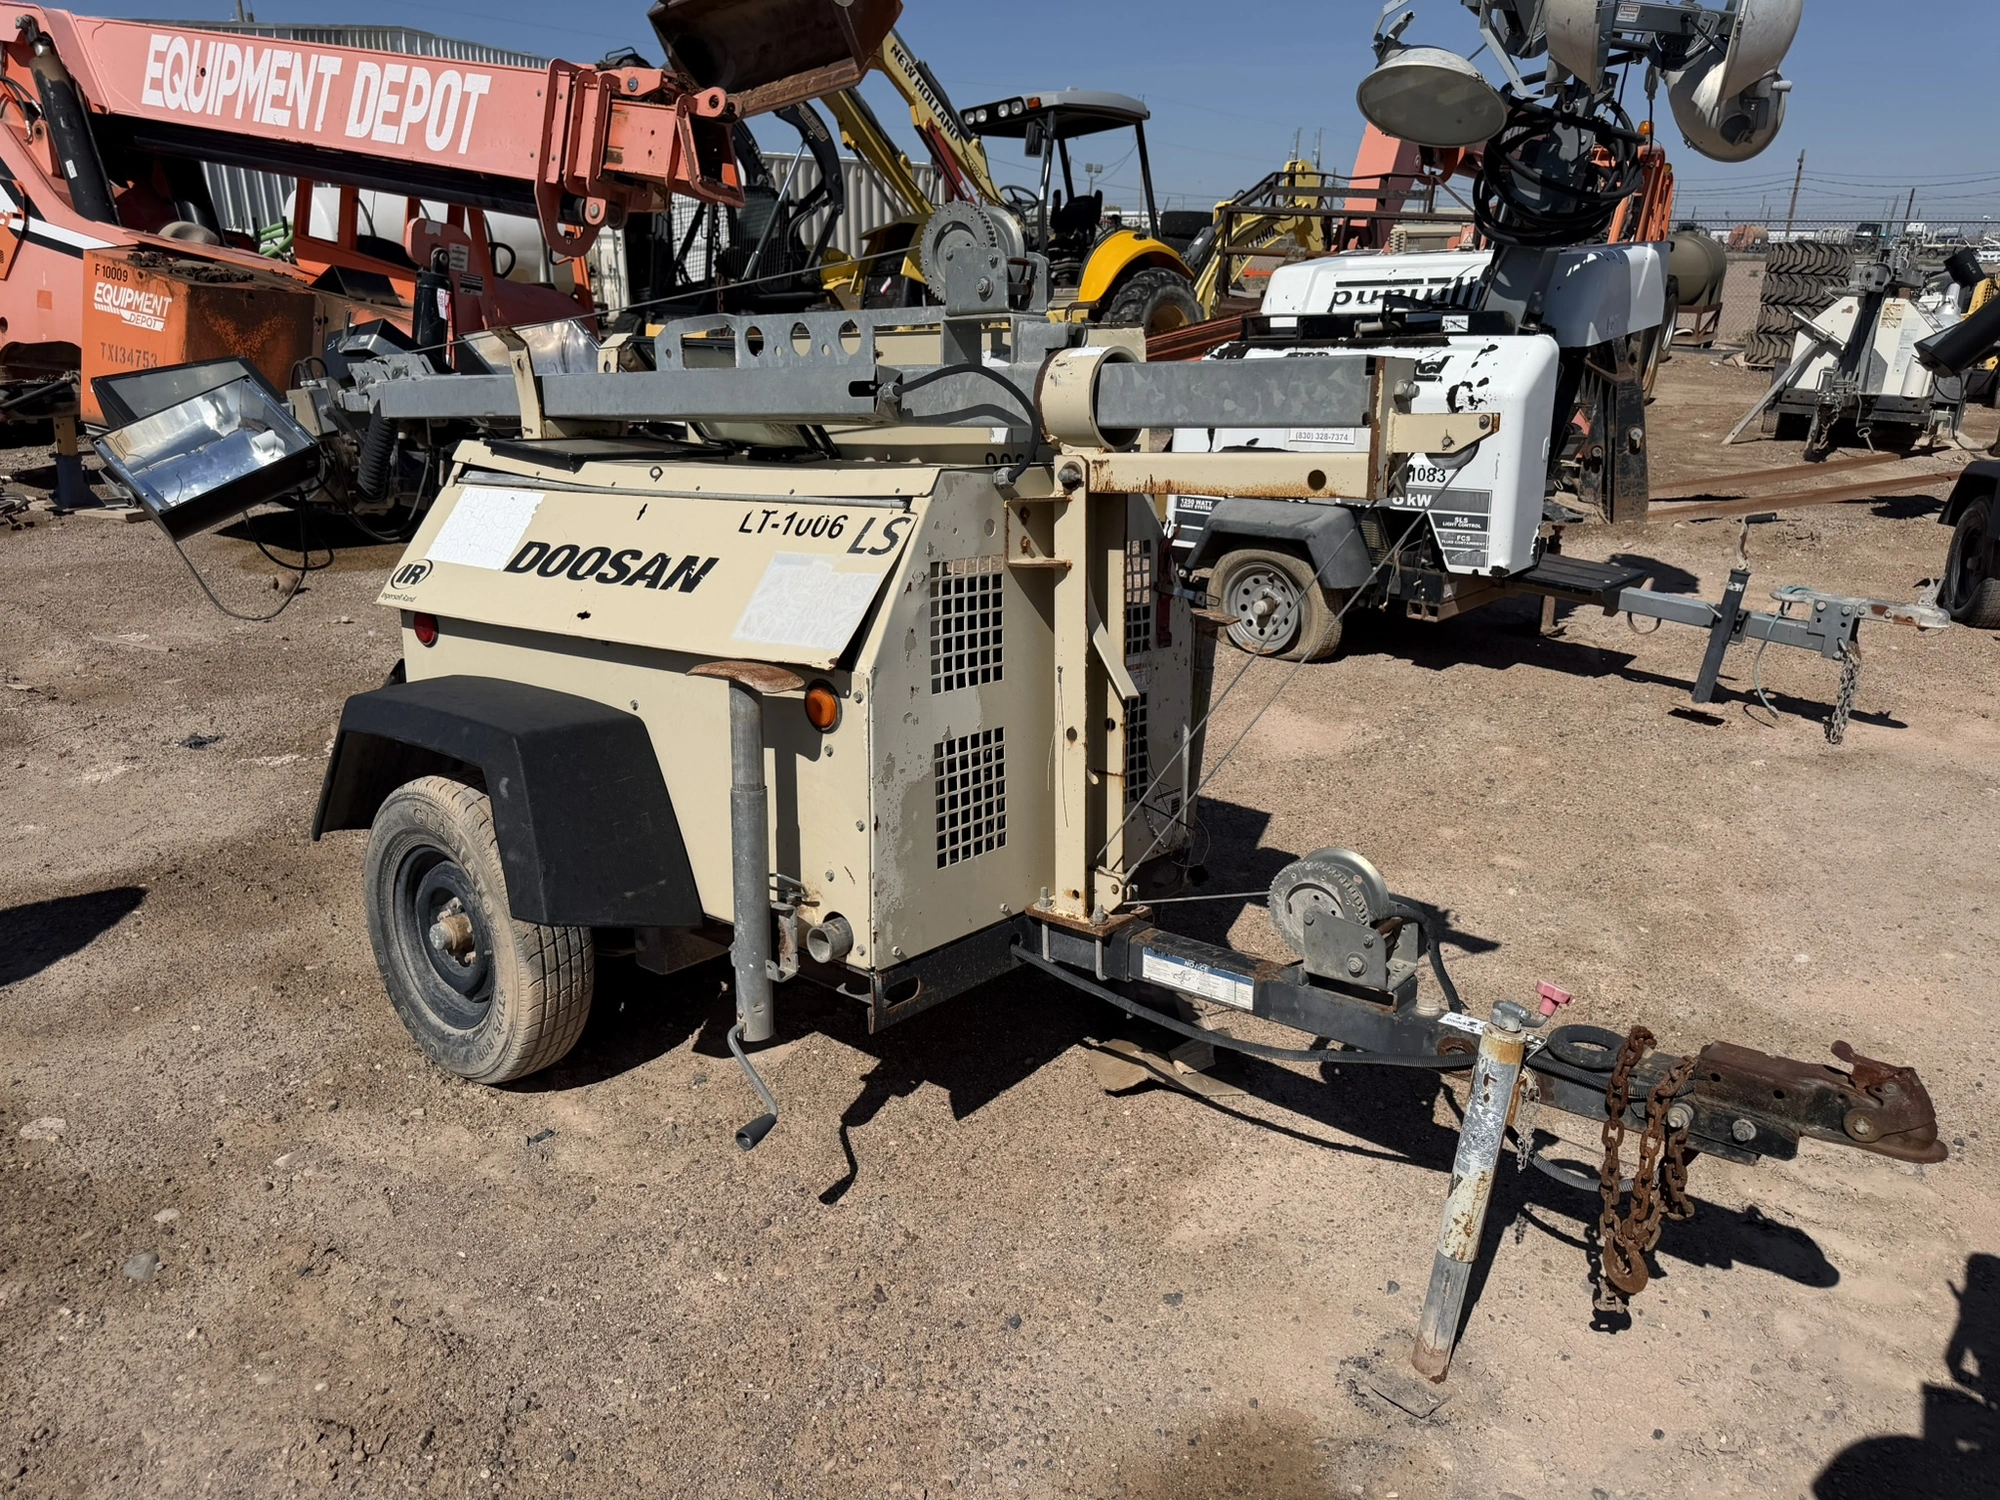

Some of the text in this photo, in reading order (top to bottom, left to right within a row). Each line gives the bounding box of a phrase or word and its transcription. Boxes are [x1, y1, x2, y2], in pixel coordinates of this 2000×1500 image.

[142, 34, 492, 154] EQUIPMENT DEPOT
[890, 44, 961, 141] NEW HOLLAND
[95, 264, 128, 282] F 10009
[94, 282, 173, 317] EQUIPMENT
[129, 313, 159, 328] DEPOT
[1295, 431, 1348, 441] (830) 328-7374
[1196, 499, 1213, 507] WATT
[847, 517, 912, 556] LS
[395, 563, 427, 585] IR
[503, 541, 720, 594] DOOSAN
